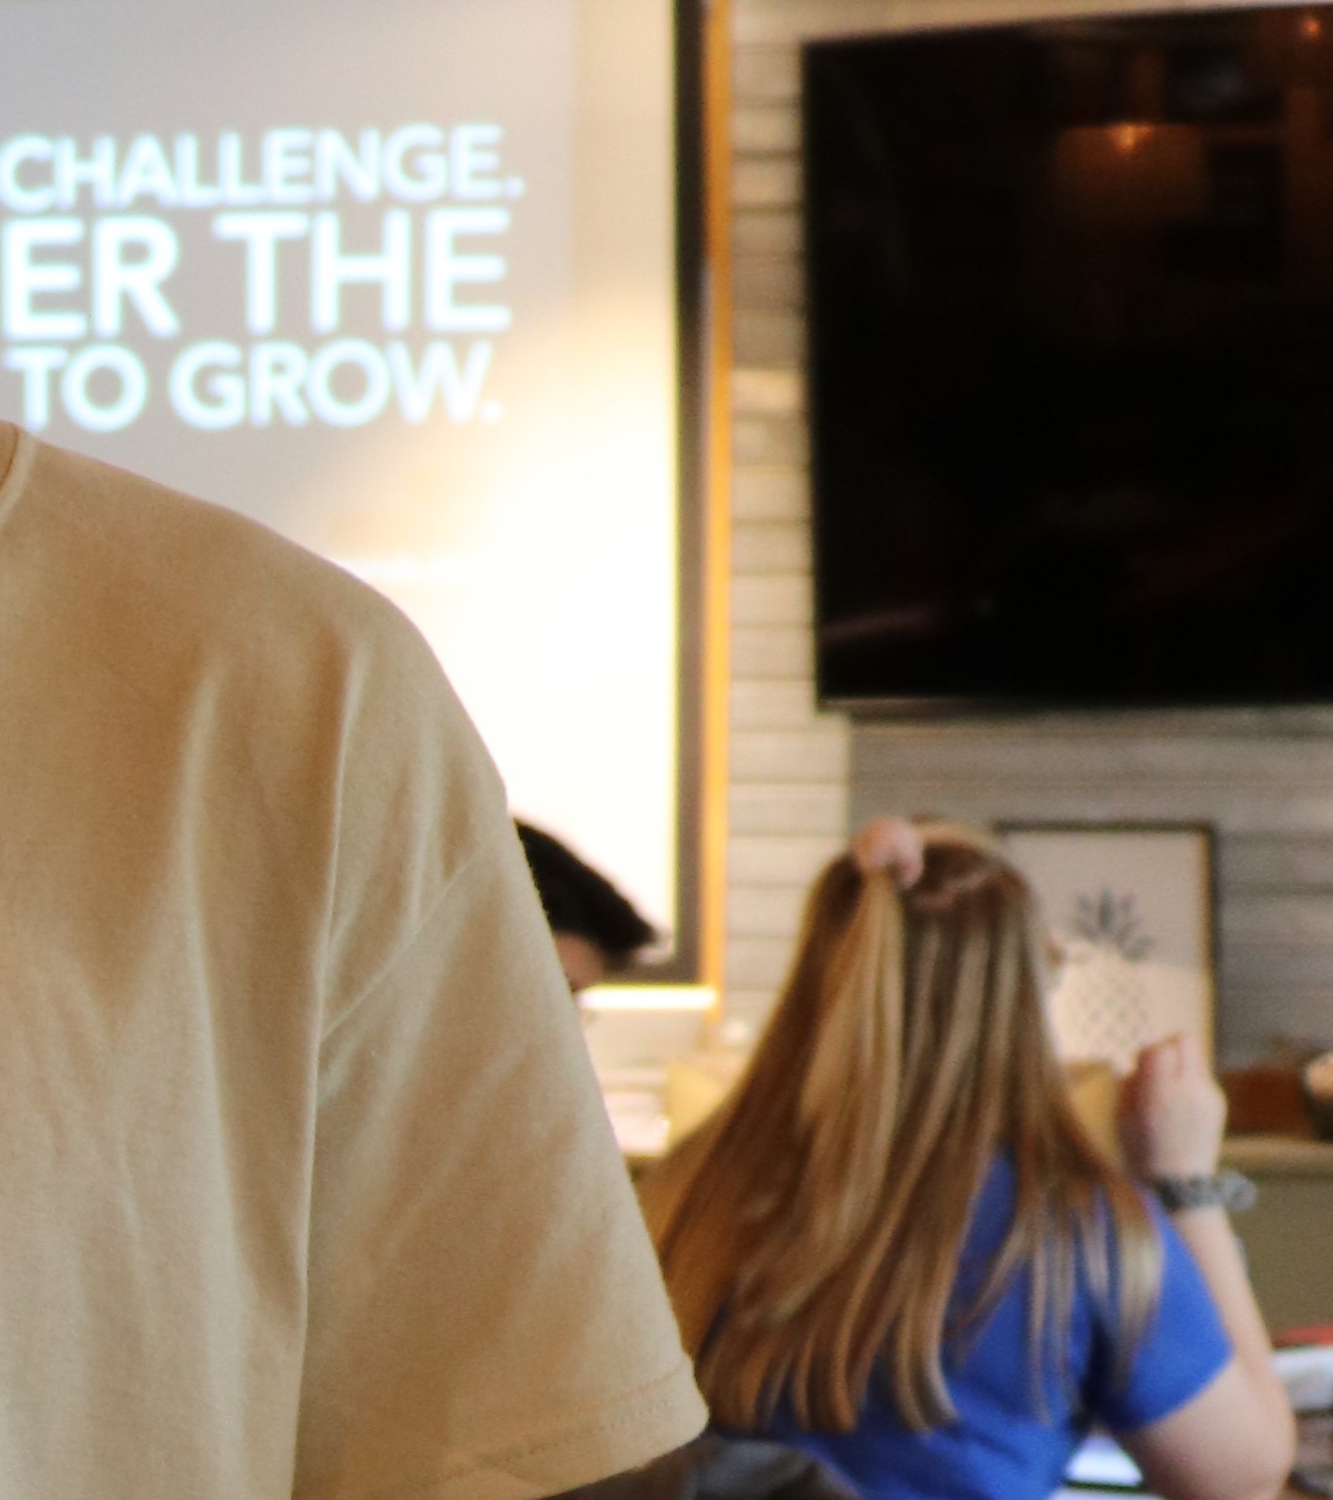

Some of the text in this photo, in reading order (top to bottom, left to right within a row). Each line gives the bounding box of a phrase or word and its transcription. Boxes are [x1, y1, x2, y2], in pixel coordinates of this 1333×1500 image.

[213, 207, 512, 337] THE
[2, 343, 149, 433] TO
[167, 338, 504, 430] GROW.
